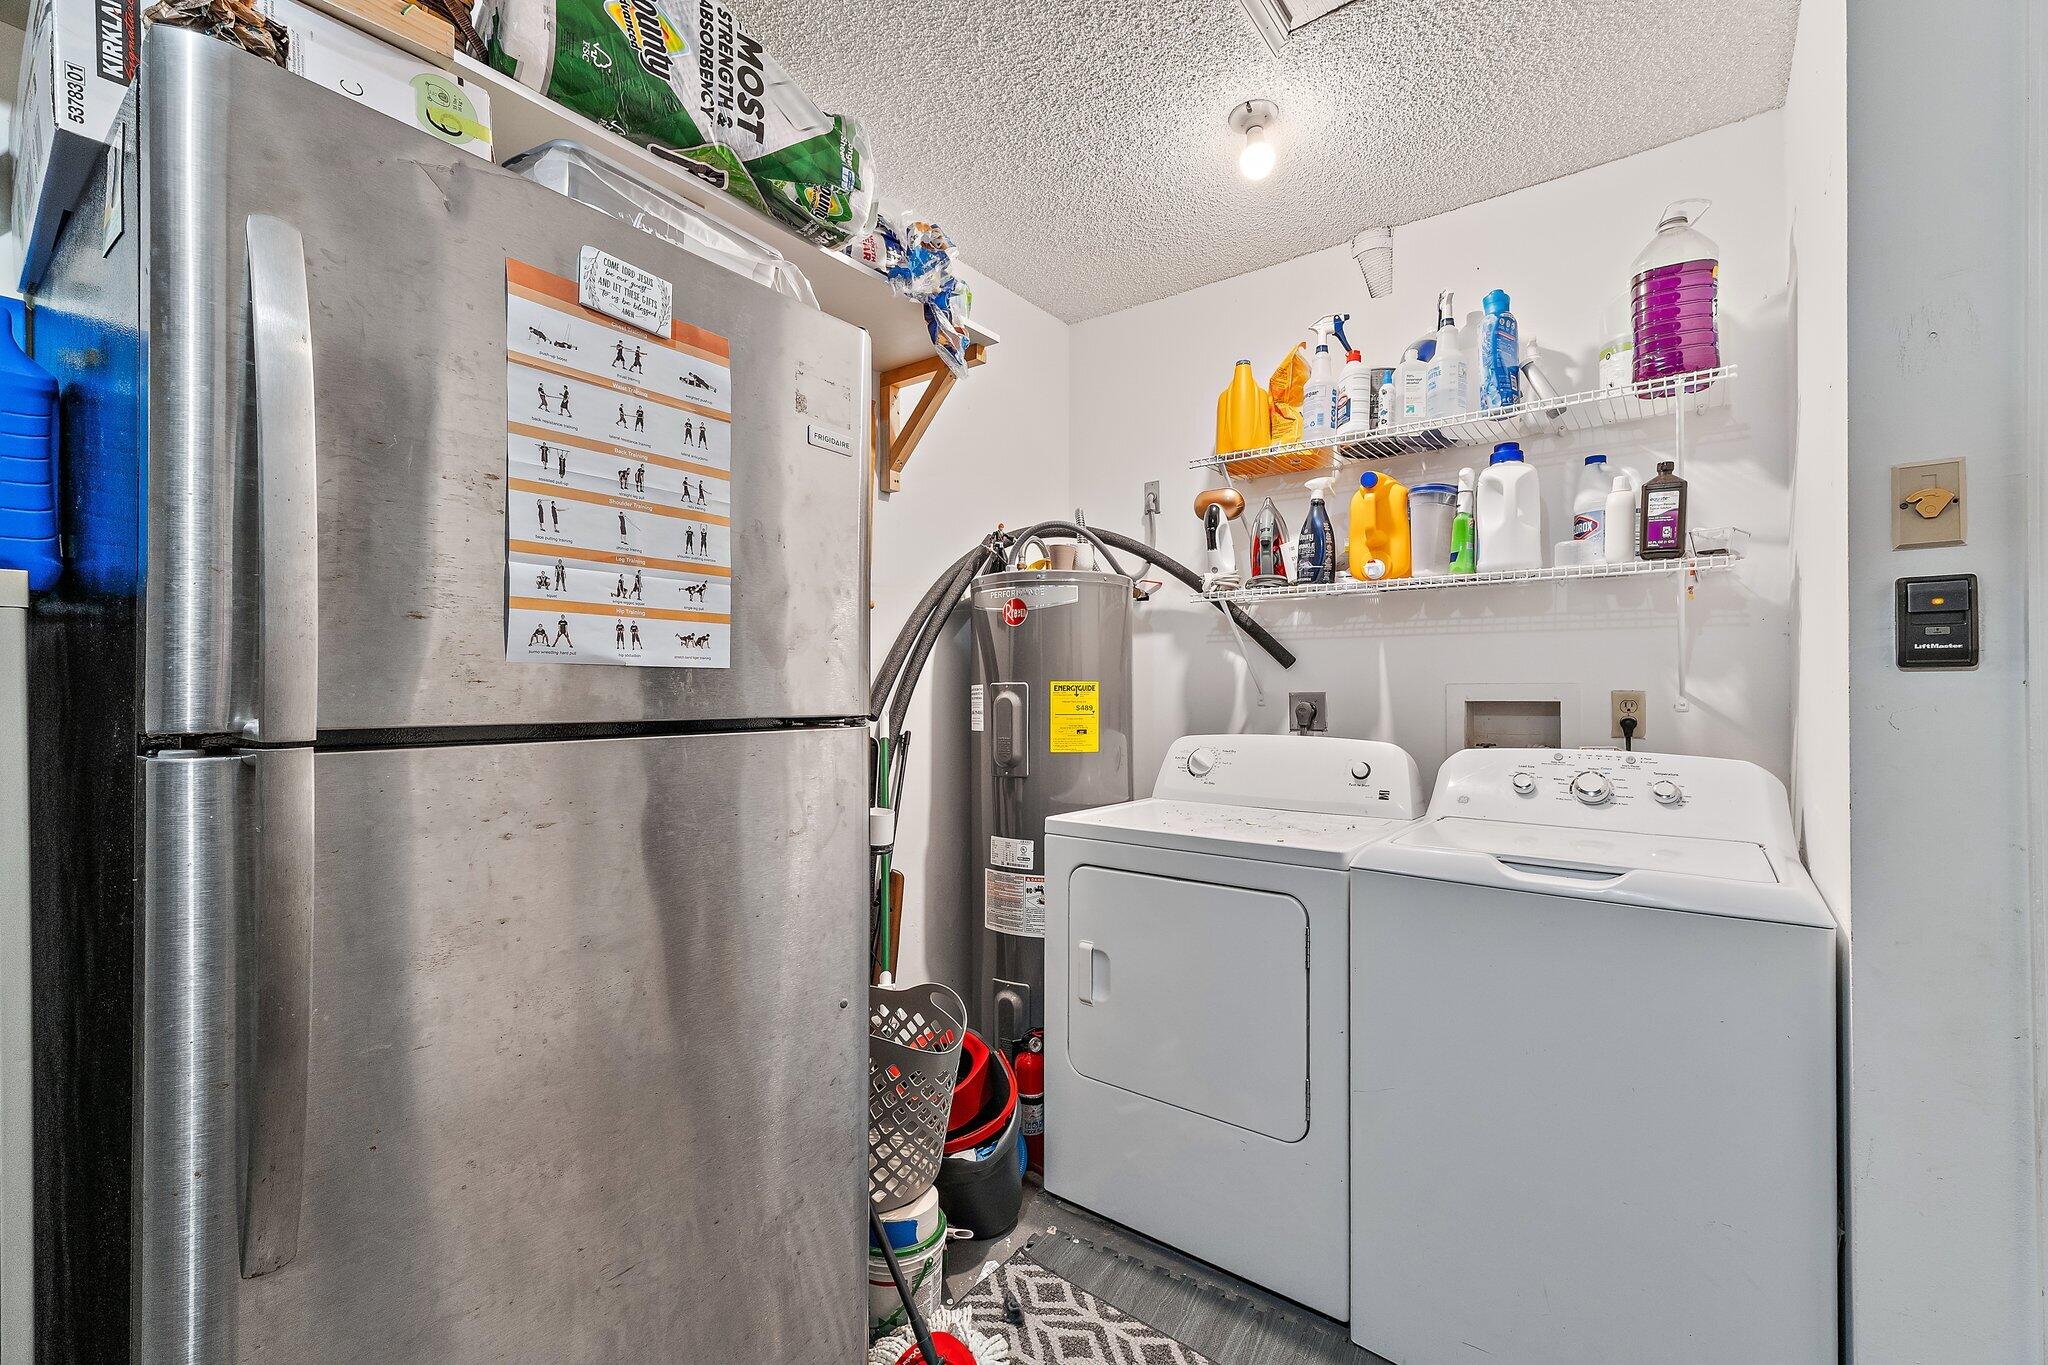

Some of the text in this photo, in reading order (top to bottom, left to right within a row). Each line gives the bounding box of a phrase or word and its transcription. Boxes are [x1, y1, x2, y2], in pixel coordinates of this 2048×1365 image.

[619, 0, 641, 51] dvanced
[632, 0, 673, 81] ounty
[717, 7, 734, 128] STRENGTH &
[737, 31, 765, 144] MOST
[814, 186, 833, 220] ounty
[603, 257, 654, 287] COME LORD JESUS
[597, 276, 658, 310] AND LET THESE GIFTS
[628, 450, 649, 461] Training
[813, 432, 850, 450] FRIGIDAIRE
[626, 557, 646, 566] Training
[625, 608, 646, 617] Training
